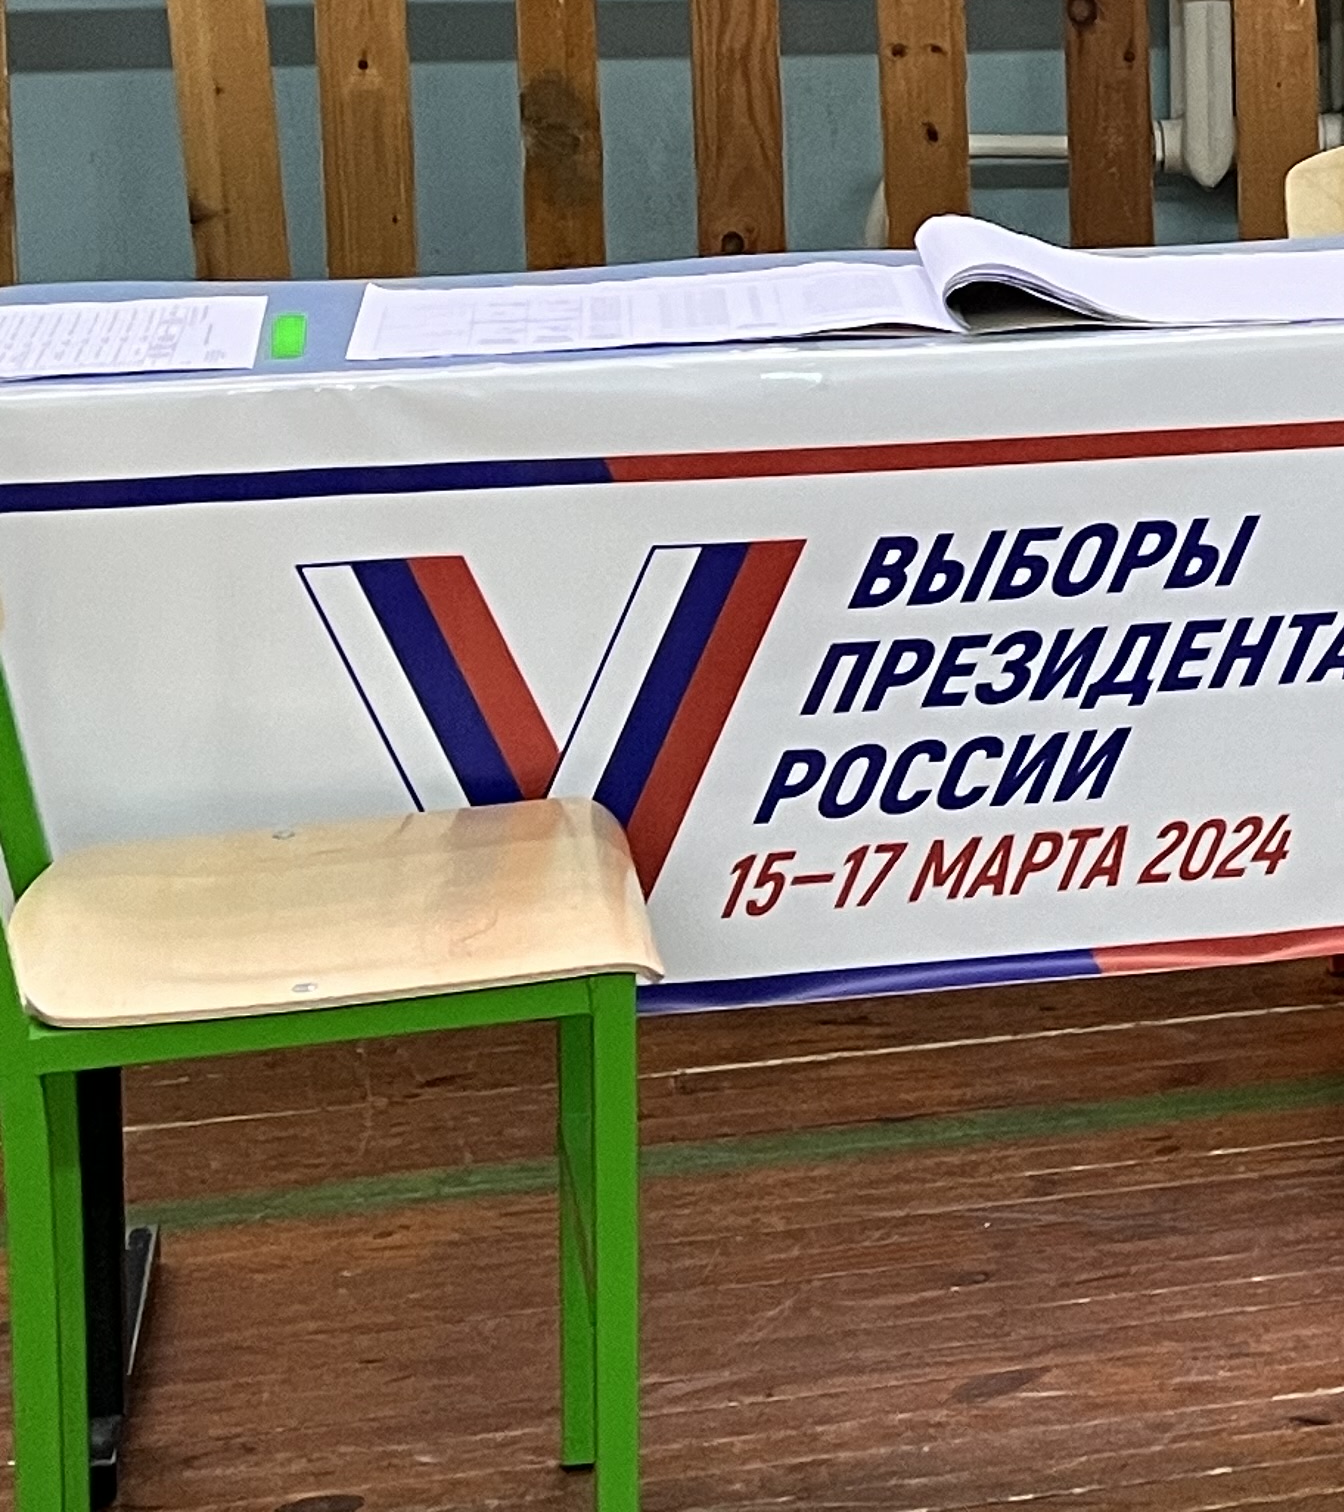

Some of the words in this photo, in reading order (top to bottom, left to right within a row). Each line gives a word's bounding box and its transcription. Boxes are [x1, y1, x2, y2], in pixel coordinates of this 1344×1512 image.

[846, 513, 1262, 611] ВЫБОРЫ
[751, 725, 1133, 826] РОССИИ
[906, 824, 1130, 906] МАРТА
[1135, 813, 1294, 887] 2024
